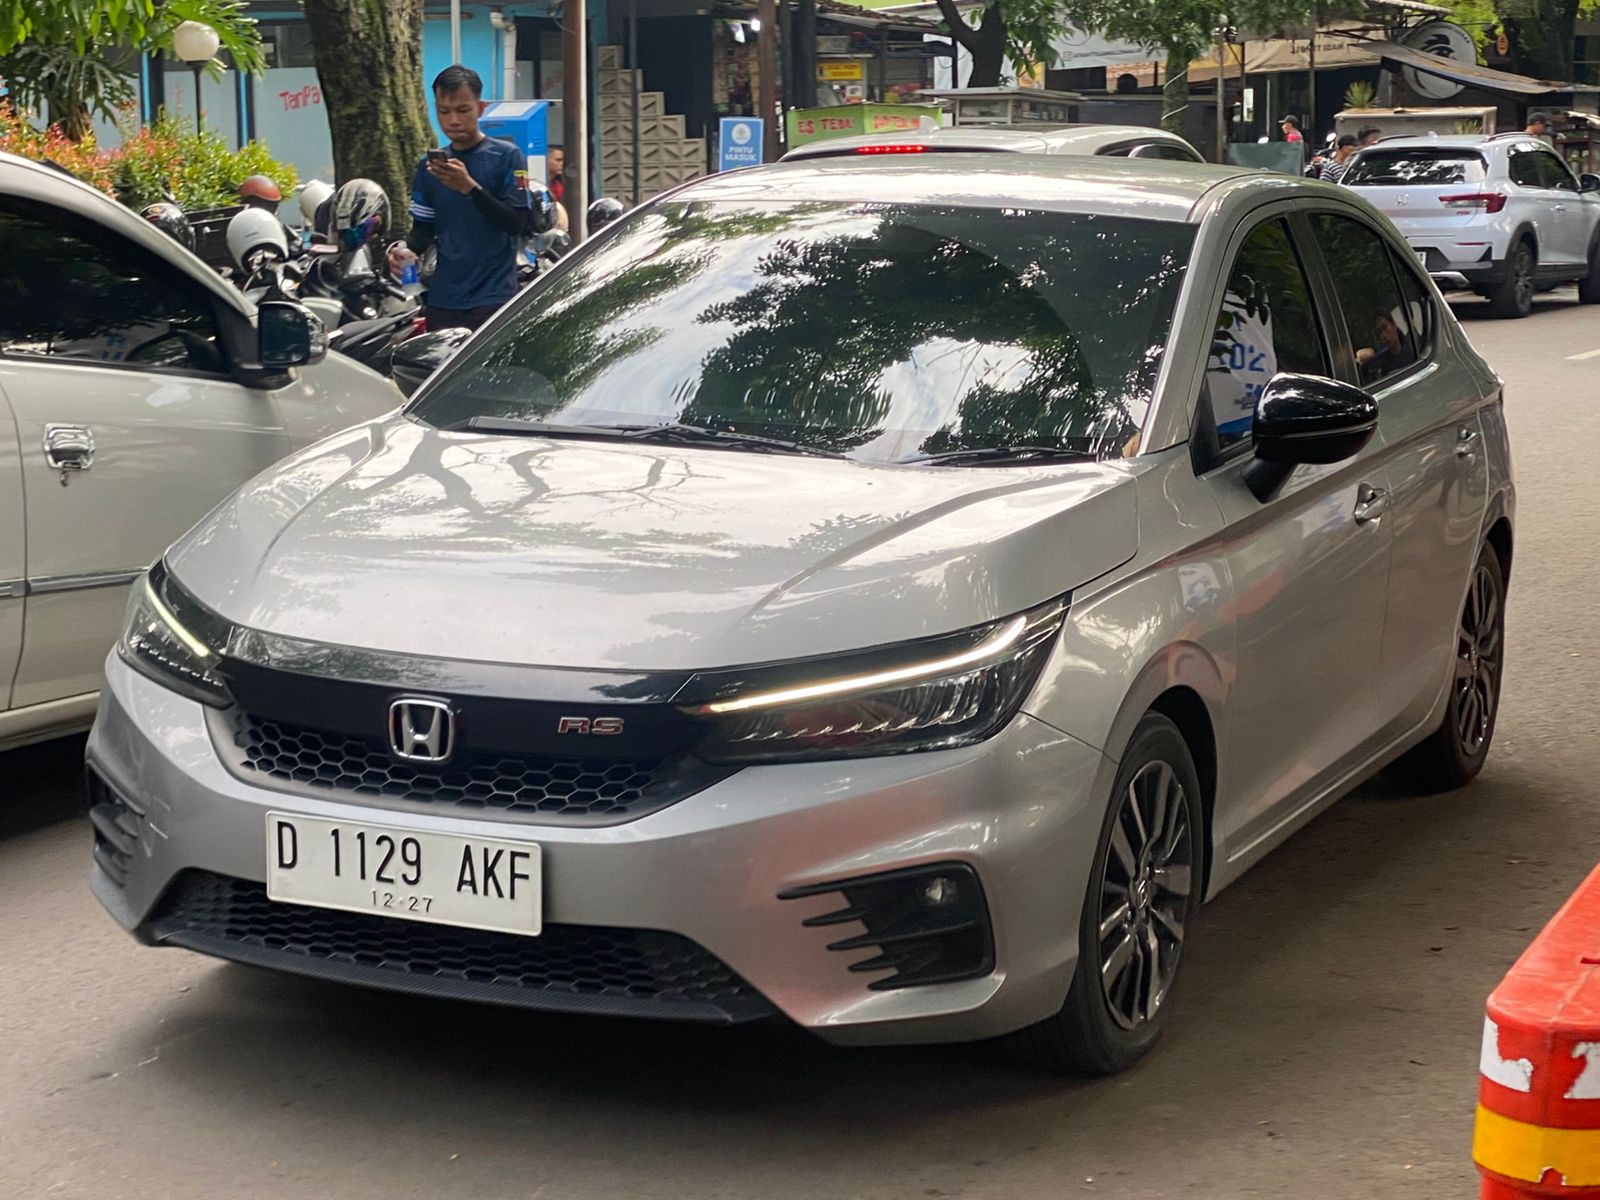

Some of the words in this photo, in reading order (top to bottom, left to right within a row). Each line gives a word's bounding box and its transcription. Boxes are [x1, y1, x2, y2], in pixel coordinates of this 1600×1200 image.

[797, 119, 815, 135] ES
[725, 153, 756, 161] MASUK
[558, 717, 624, 734] RS
[277, 821, 298, 869] D
[330, 828, 421, 886] 1129
[456, 844, 531, 900] AKF
